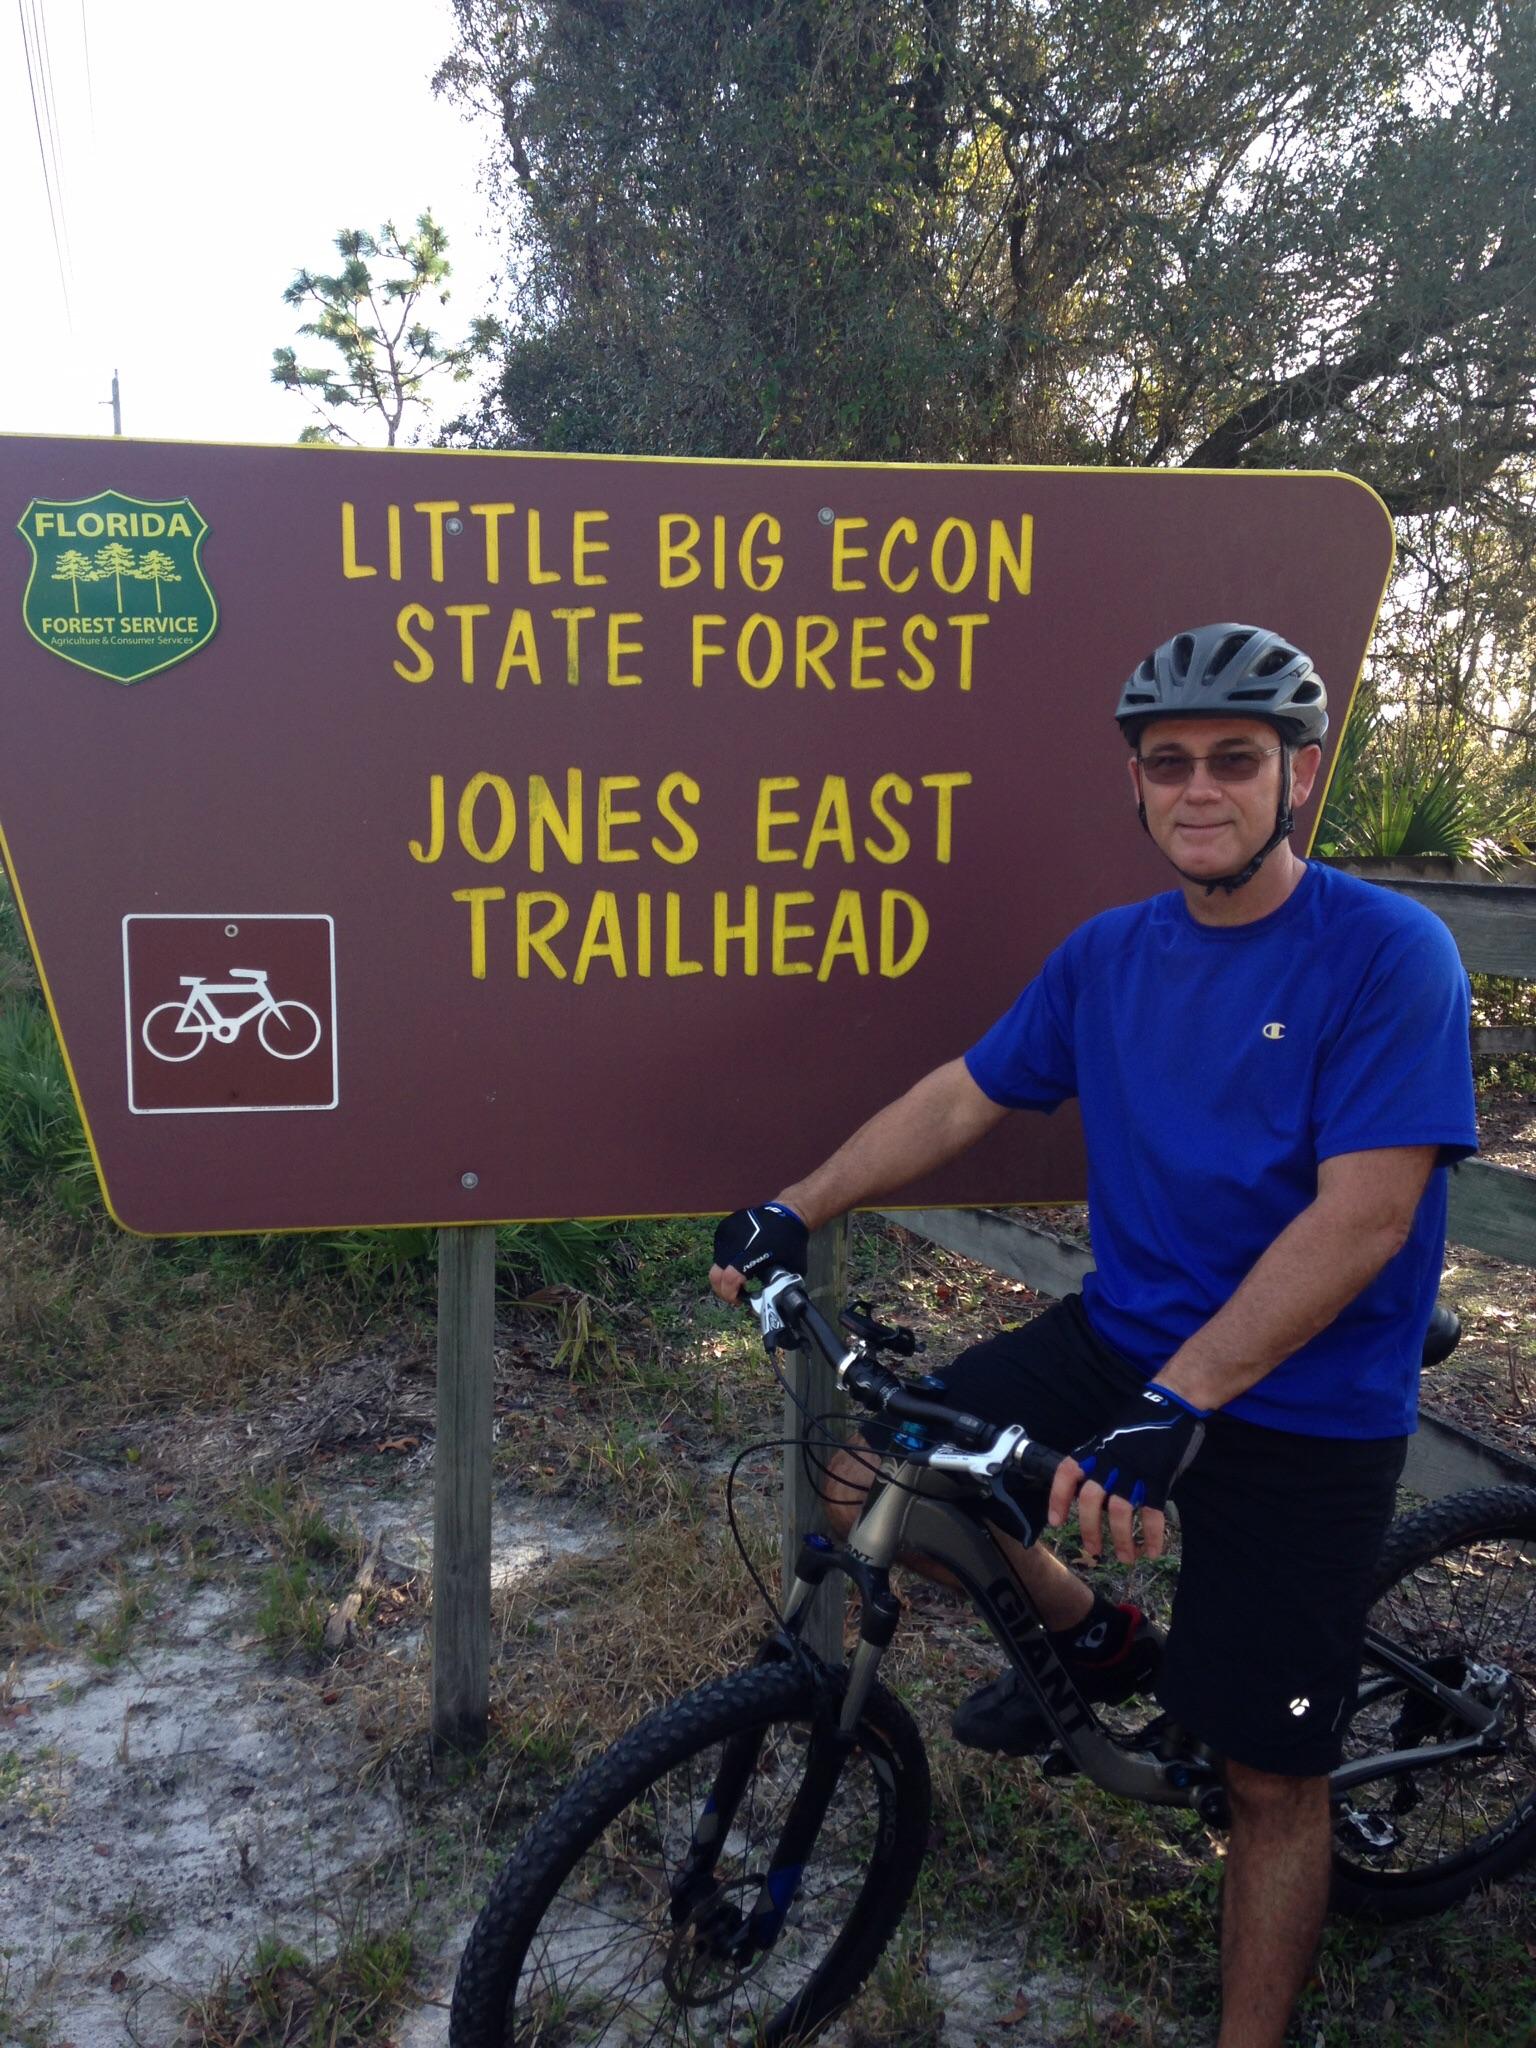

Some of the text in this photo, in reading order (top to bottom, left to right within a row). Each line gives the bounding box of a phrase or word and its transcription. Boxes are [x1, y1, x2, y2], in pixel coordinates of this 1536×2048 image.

[35, 513, 192, 537] FLORIDA
[342, 500, 1034, 602] LITTLE BIG ECON
[42, 616, 198, 634] FOREST SERVICE
[51, 636, 193, 647] Agriculture & Consumer Services
[395, 604, 990, 692] STATE FOREST
[409, 768, 972, 873] JONES EAST
[452, 884, 929, 983] TRAILHEAD
[985, 1577, 1095, 1732] GIANT
